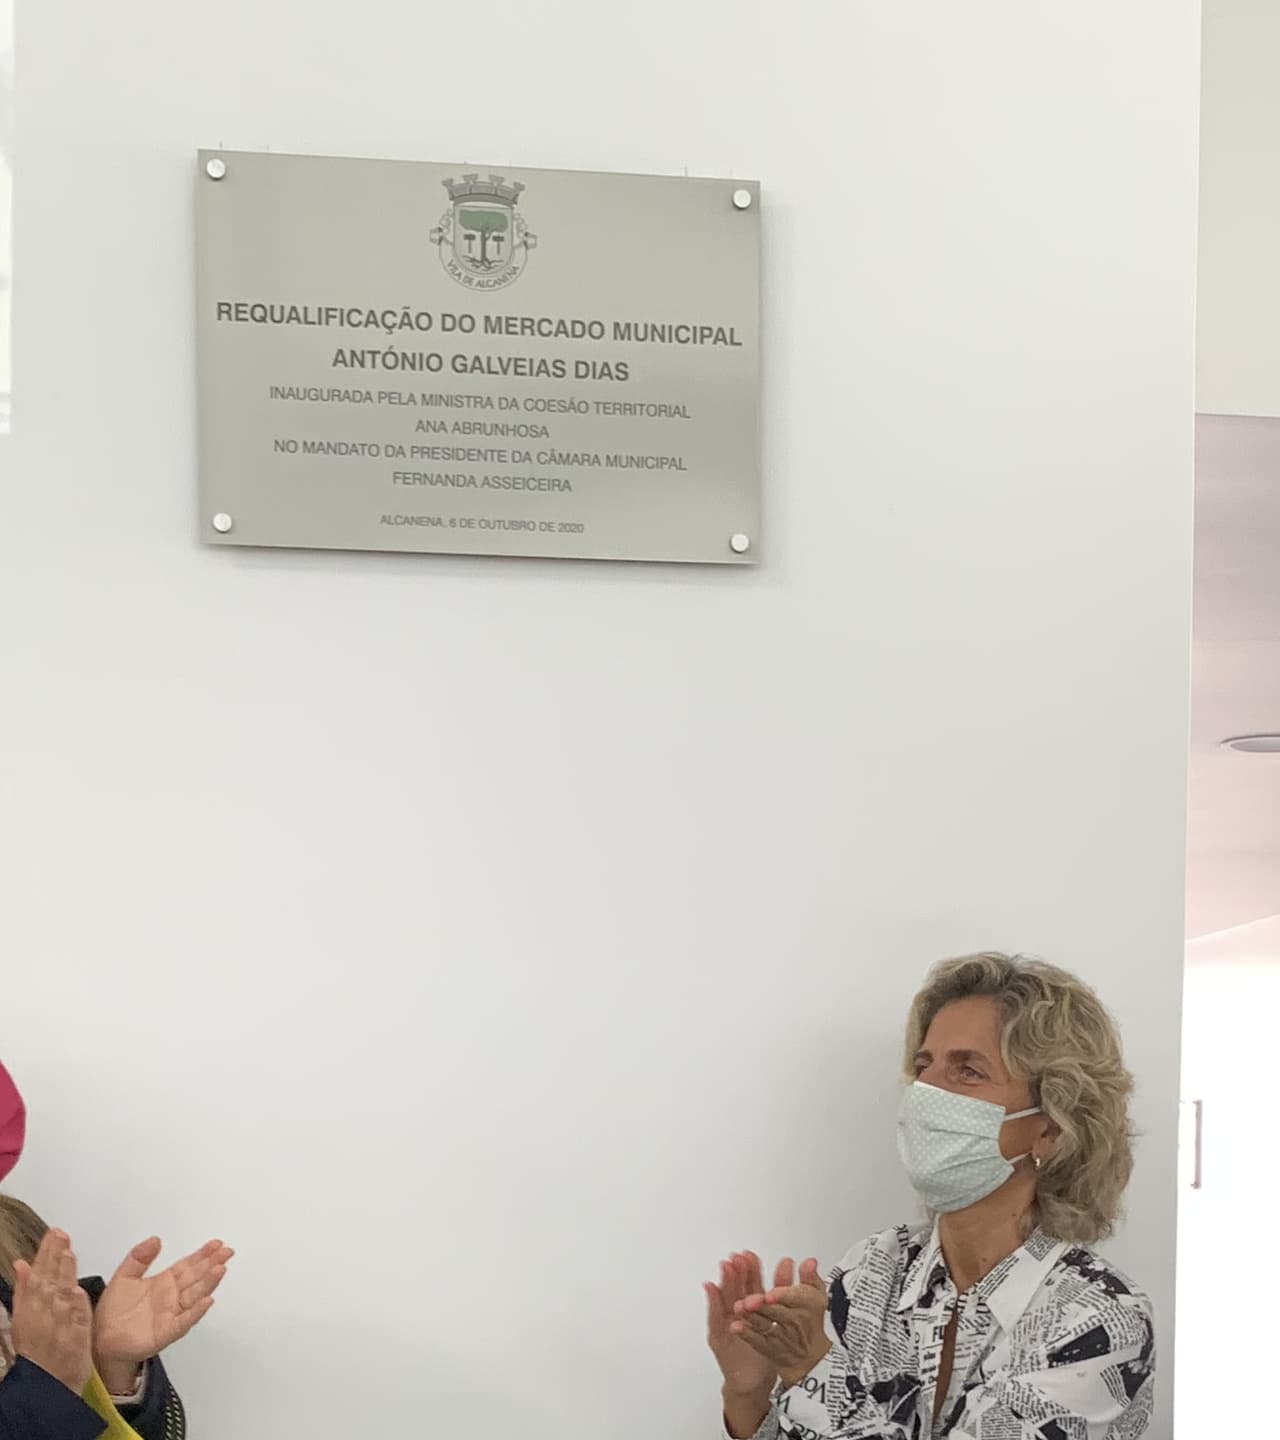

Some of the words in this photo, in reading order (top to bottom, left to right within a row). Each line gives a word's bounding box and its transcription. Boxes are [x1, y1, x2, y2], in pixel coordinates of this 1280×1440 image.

[462, 275, 474, 287] DE
[217, 302, 433, 335] REQUALIFICAÇÃO
[441, 313, 475, 333] DO
[484, 315, 605, 340] MERCADO
[613, 322, 742, 346] MUNICIPAL
[332, 345, 443, 372] ANTÓNIO
[451, 354, 566, 378] GALVEIAS
[575, 360, 629, 381] DIAS
[270, 386, 373, 403] INAUGURADA
[378, 391, 417, 405] PELA
[421, 393, 494, 408] MINISTRA
[498, 397, 519, 410] DA
[523, 397, 589, 414] COESÃO
[593, 401, 691, 419] TERRITORIAL
[416, 420, 448, 433] ANA
[451, 421, 549, 438] ABRUNHOSA
[274, 440, 298, 453] NO
[303, 440, 380, 457] MANDATO
[385, 445, 406, 458] DA
[411, 446, 507, 463] PRESIDENTE
[512, 450, 532, 463] DA
[537, 449, 601, 466] CÂMARA
[606, 455, 687, 471] MUNICIPAL
[393, 472, 477, 488] FERNANDA
[481, 476, 572, 492] ASSEICEIRA
